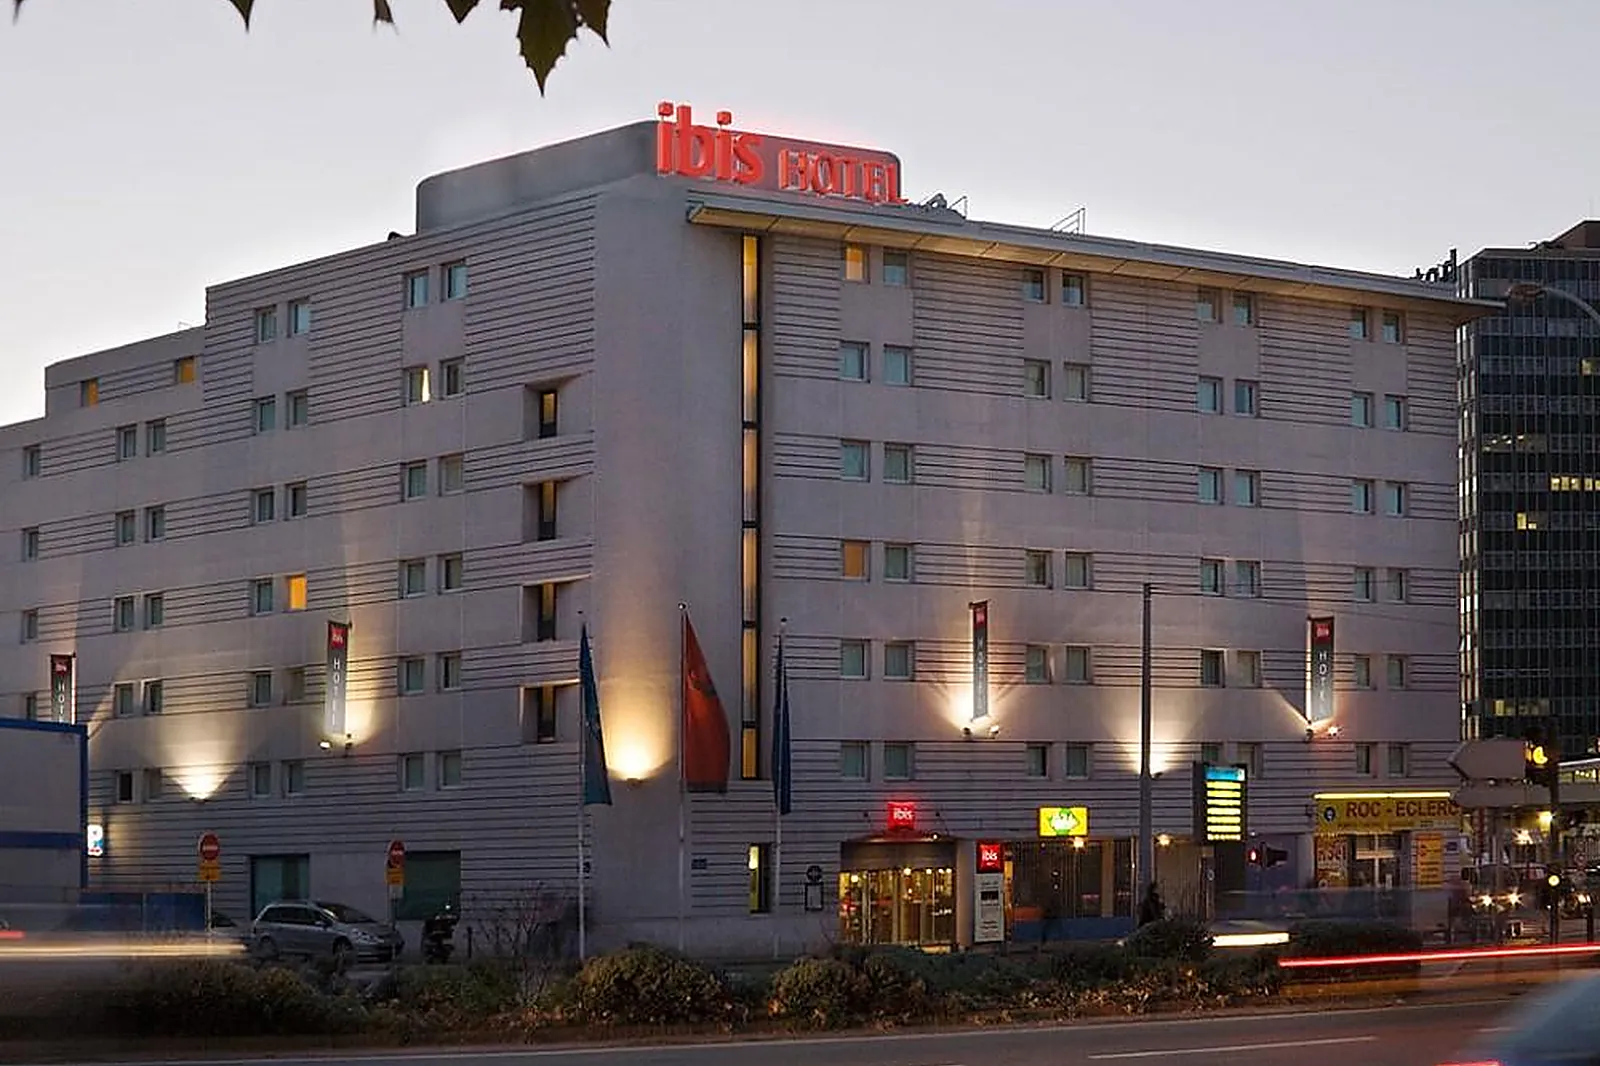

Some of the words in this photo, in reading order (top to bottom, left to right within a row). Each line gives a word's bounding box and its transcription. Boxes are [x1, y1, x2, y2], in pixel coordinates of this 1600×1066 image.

[657, 101, 764, 184] ibis
[778, 149, 908, 203] HOTEL
[893, 807, 913, 820] ibis
[1346, 801, 1382, 818] ROC
